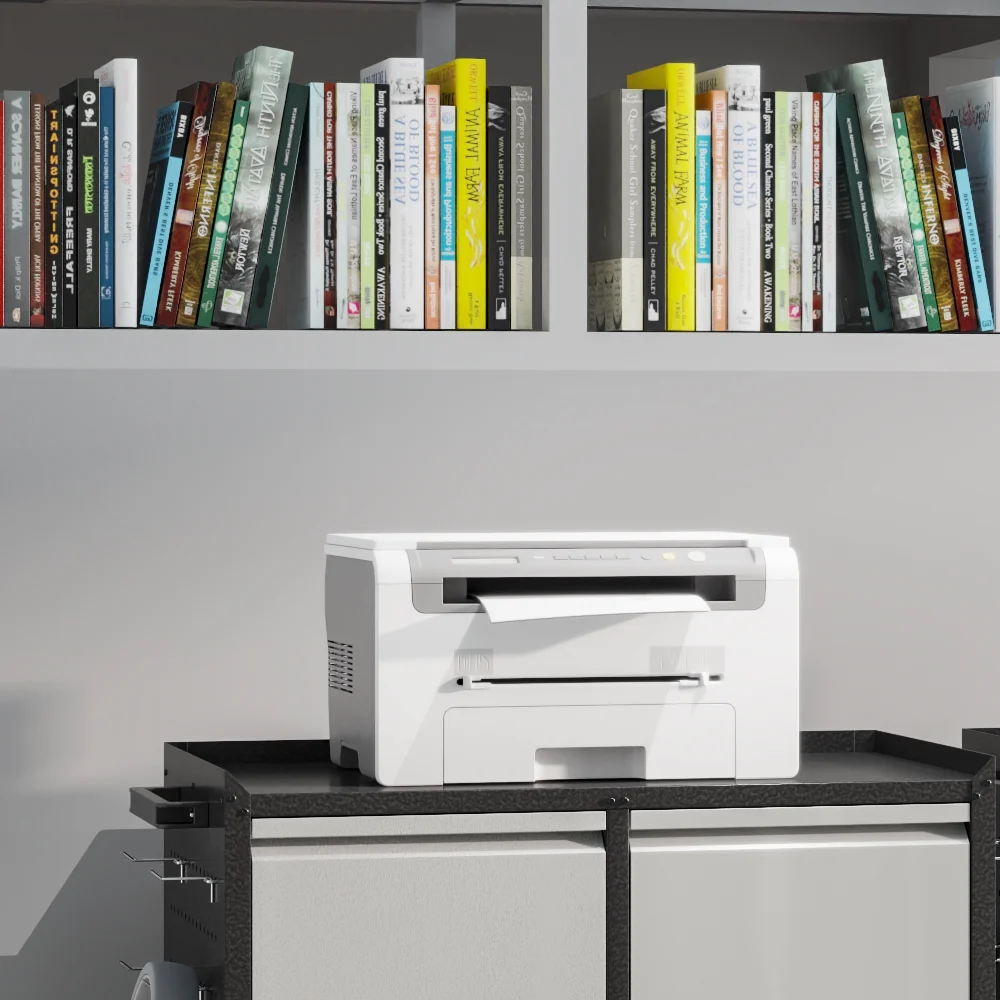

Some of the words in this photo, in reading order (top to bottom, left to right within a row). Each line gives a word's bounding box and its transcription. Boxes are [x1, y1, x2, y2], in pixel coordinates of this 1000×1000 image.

[763, 98, 773, 113] paul
[791, 99, 799, 122] Viking
[733, 125, 744, 144] OF
[748, 122, 757, 131] A
[763, 114, 771, 134] green
[791, 123, 799, 143] Place
[674, 111, 689, 165] ANIMAL
[950, 128, 961, 151] BIXBY
[699, 148, 708, 183] Business
[748, 138, 757, 177] BLUE
[764, 144, 774, 169] Second
[791, 145, 799, 169] Names
[674, 170, 689, 206] FARM
[733, 150, 744, 206] BLOOD
[764, 170, 774, 196] Chance
[791, 181, 799, 196] East
[699, 185, 708, 201] and
[748, 182, 757, 209] SEA
[764, 197, 774, 218] Series
[791, 198, 799, 225] Lothian
[699, 203, 708, 248] Production
[764, 223, 774, 241] Book
[764, 243, 773, 259] Two
[893, 236, 908, 281] NEWTON
[763, 270, 773, 323] AWAKENING
[954, 258, 965, 294] KIMBERLY
[960, 296, 970, 318] FLEEK
